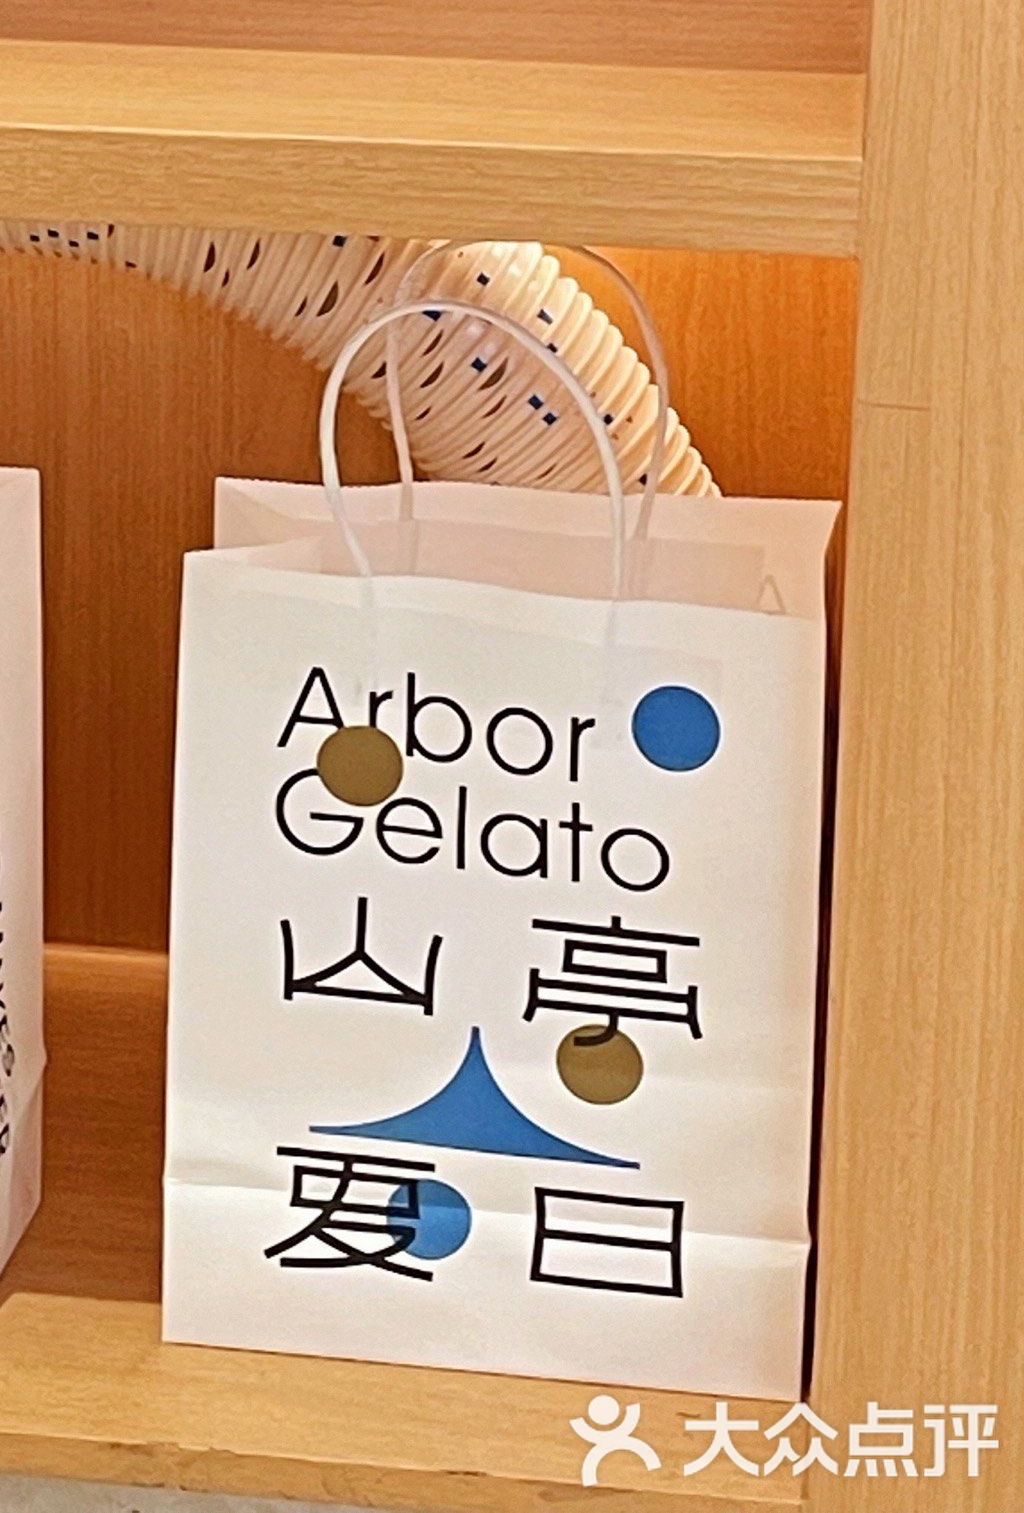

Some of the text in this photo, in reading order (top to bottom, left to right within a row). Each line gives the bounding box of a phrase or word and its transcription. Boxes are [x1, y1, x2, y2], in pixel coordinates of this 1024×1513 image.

[277, 667, 595, 782] Arbor
[276, 768, 671, 892] Gelato
[280, 897, 703, 1047] 山亭
[264, 1146, 685, 1299] 夏日
